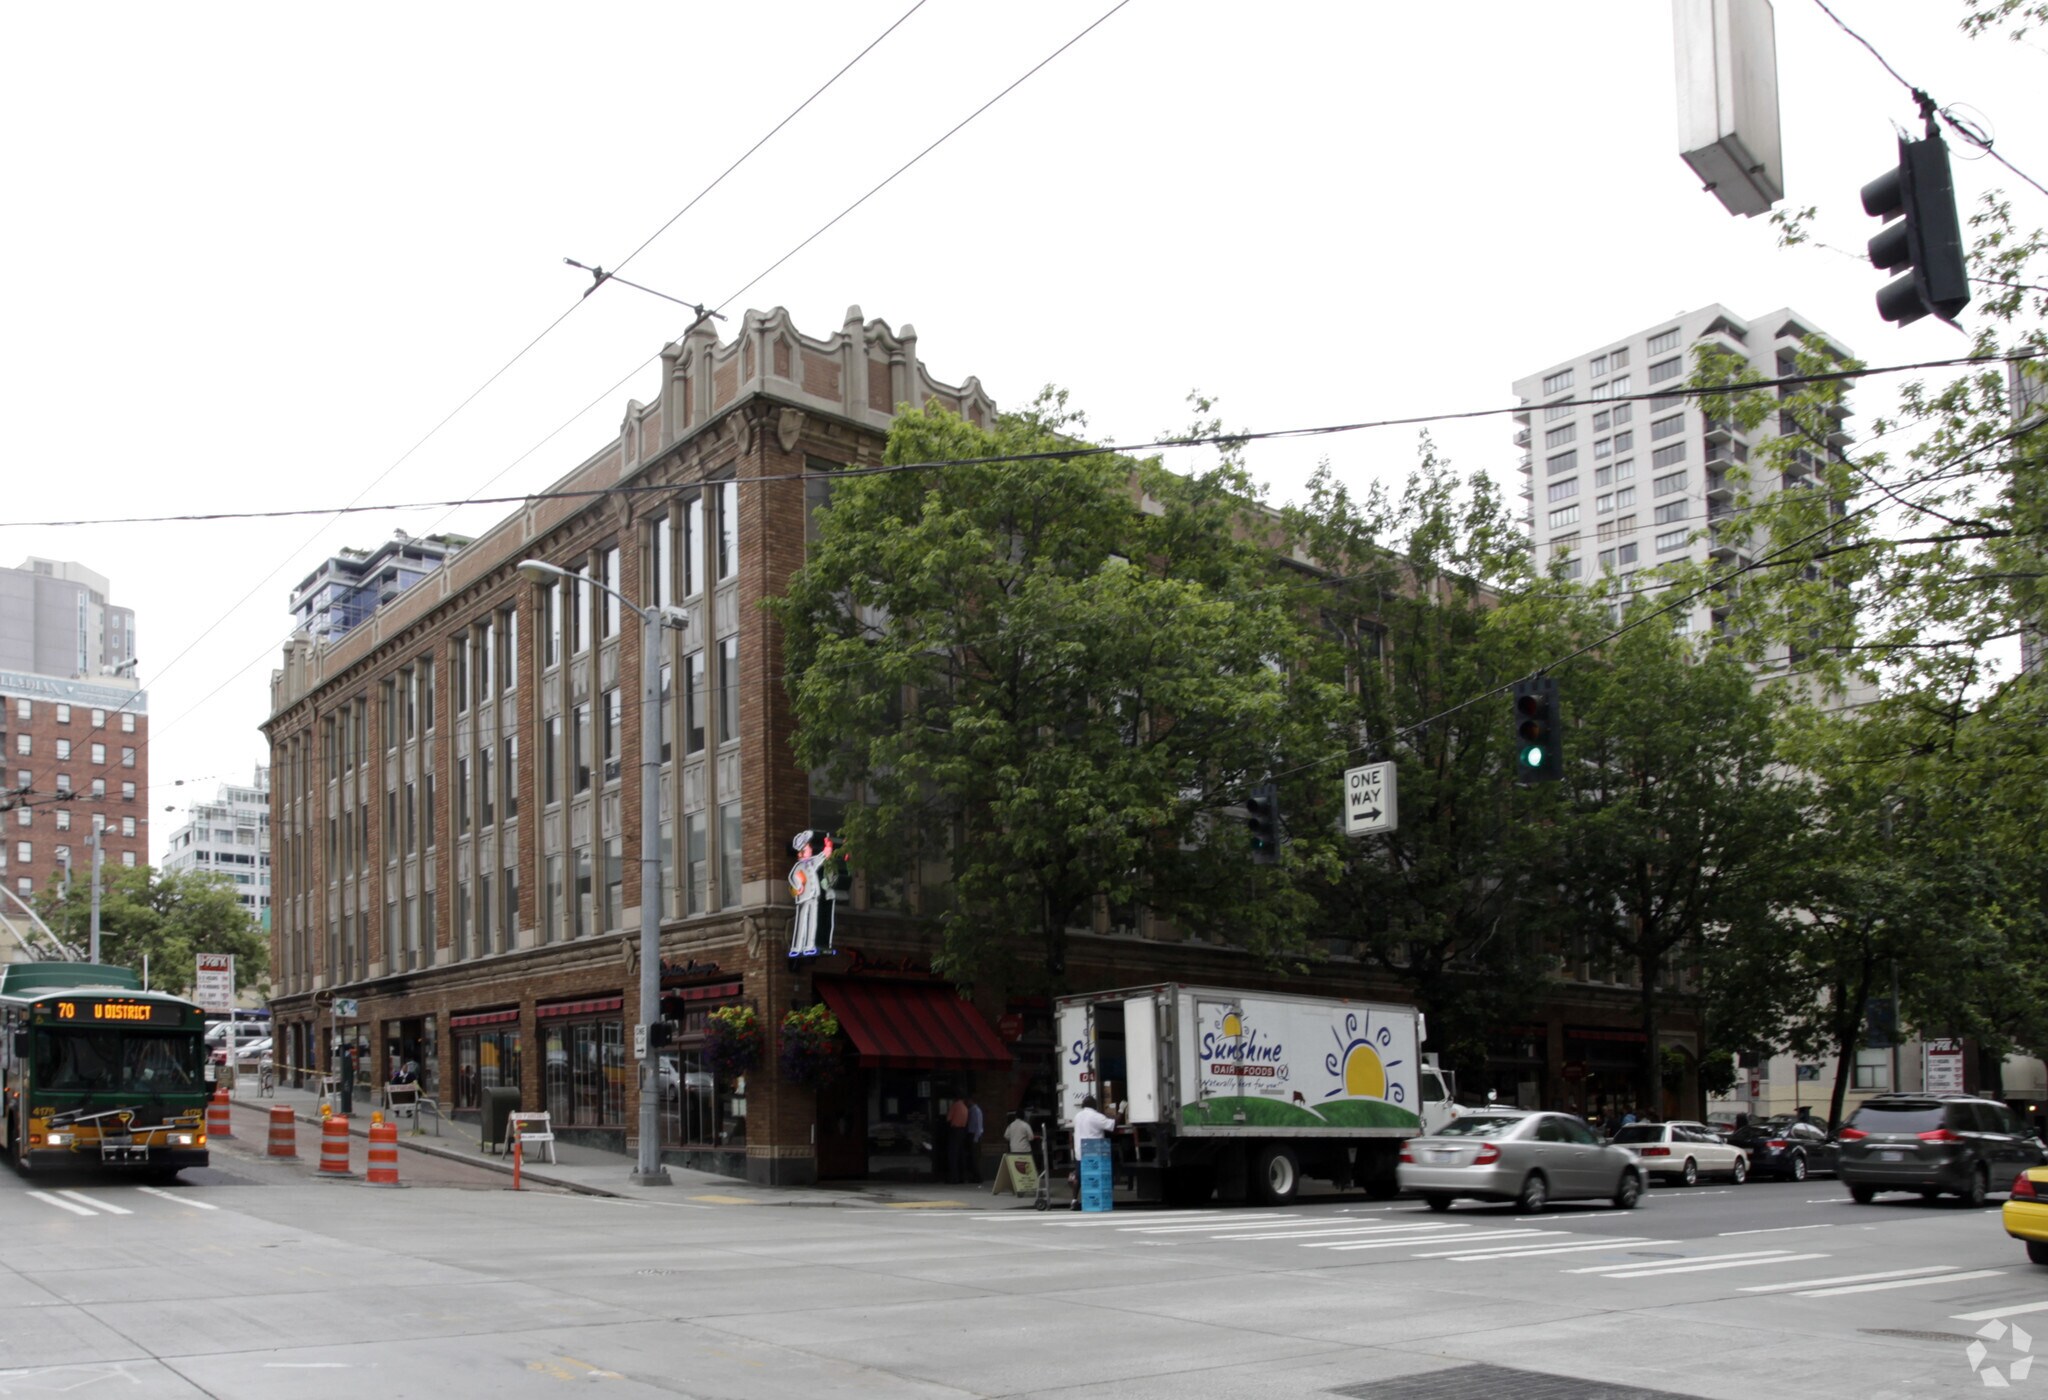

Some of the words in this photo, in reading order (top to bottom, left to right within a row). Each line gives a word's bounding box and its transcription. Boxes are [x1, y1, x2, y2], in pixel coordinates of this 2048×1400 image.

[1351, 770, 1381, 788] ONE
[1351, 788, 1381, 806] WAY
[58, 1002, 75, 1019] 70
[94, 1005, 103, 1019] U
[104, 1005, 151, 1020] DISTRICT
[1200, 1029, 1282, 1062] Sunshine
[1213, 1065, 1237, 1075] DAIR
[1243, 1066, 1274, 1076] FOODS
